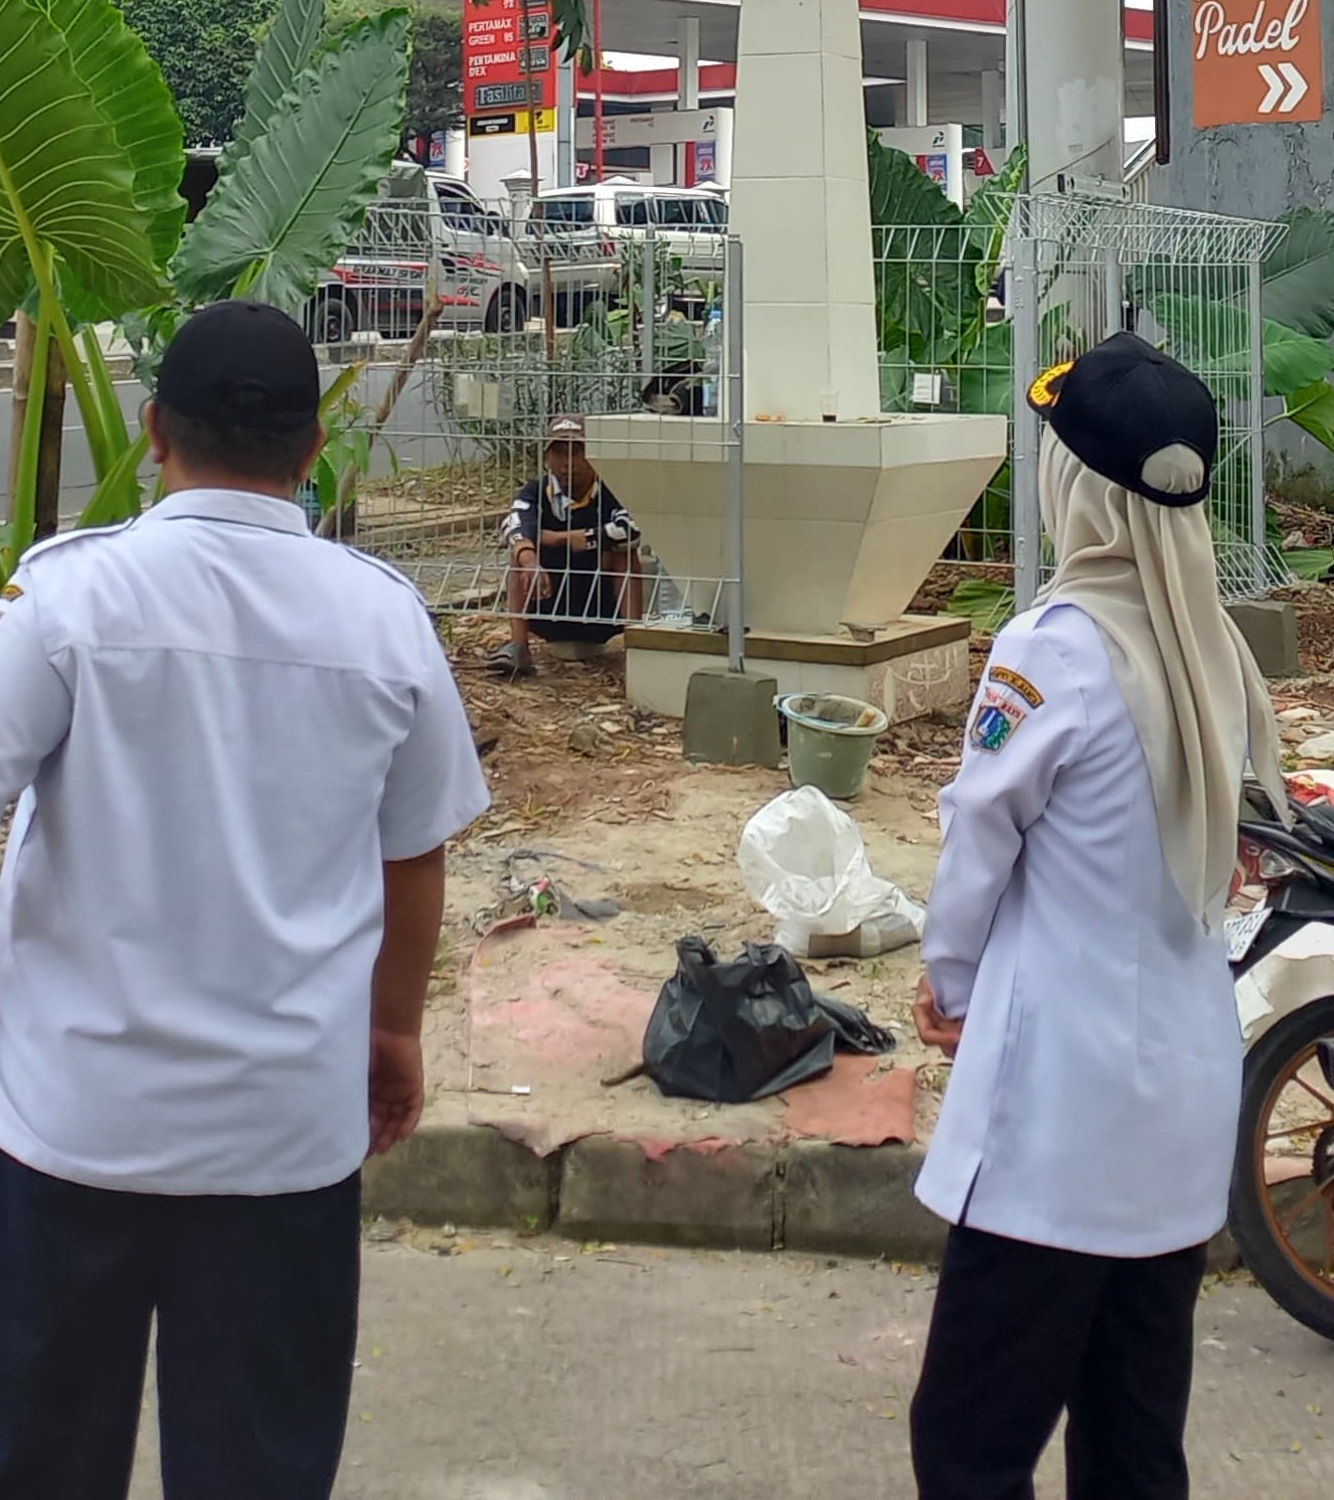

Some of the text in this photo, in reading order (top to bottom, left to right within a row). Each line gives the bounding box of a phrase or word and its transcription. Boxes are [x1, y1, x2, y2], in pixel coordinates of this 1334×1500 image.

[468, 18, 513, 33] PERTAMAX
[468, 51, 517, 67] PERTAMINA
[468, 66, 487, 78] DEX
[479, 84, 531, 105] Fasilita
[977, 156, 985, 168] 7
